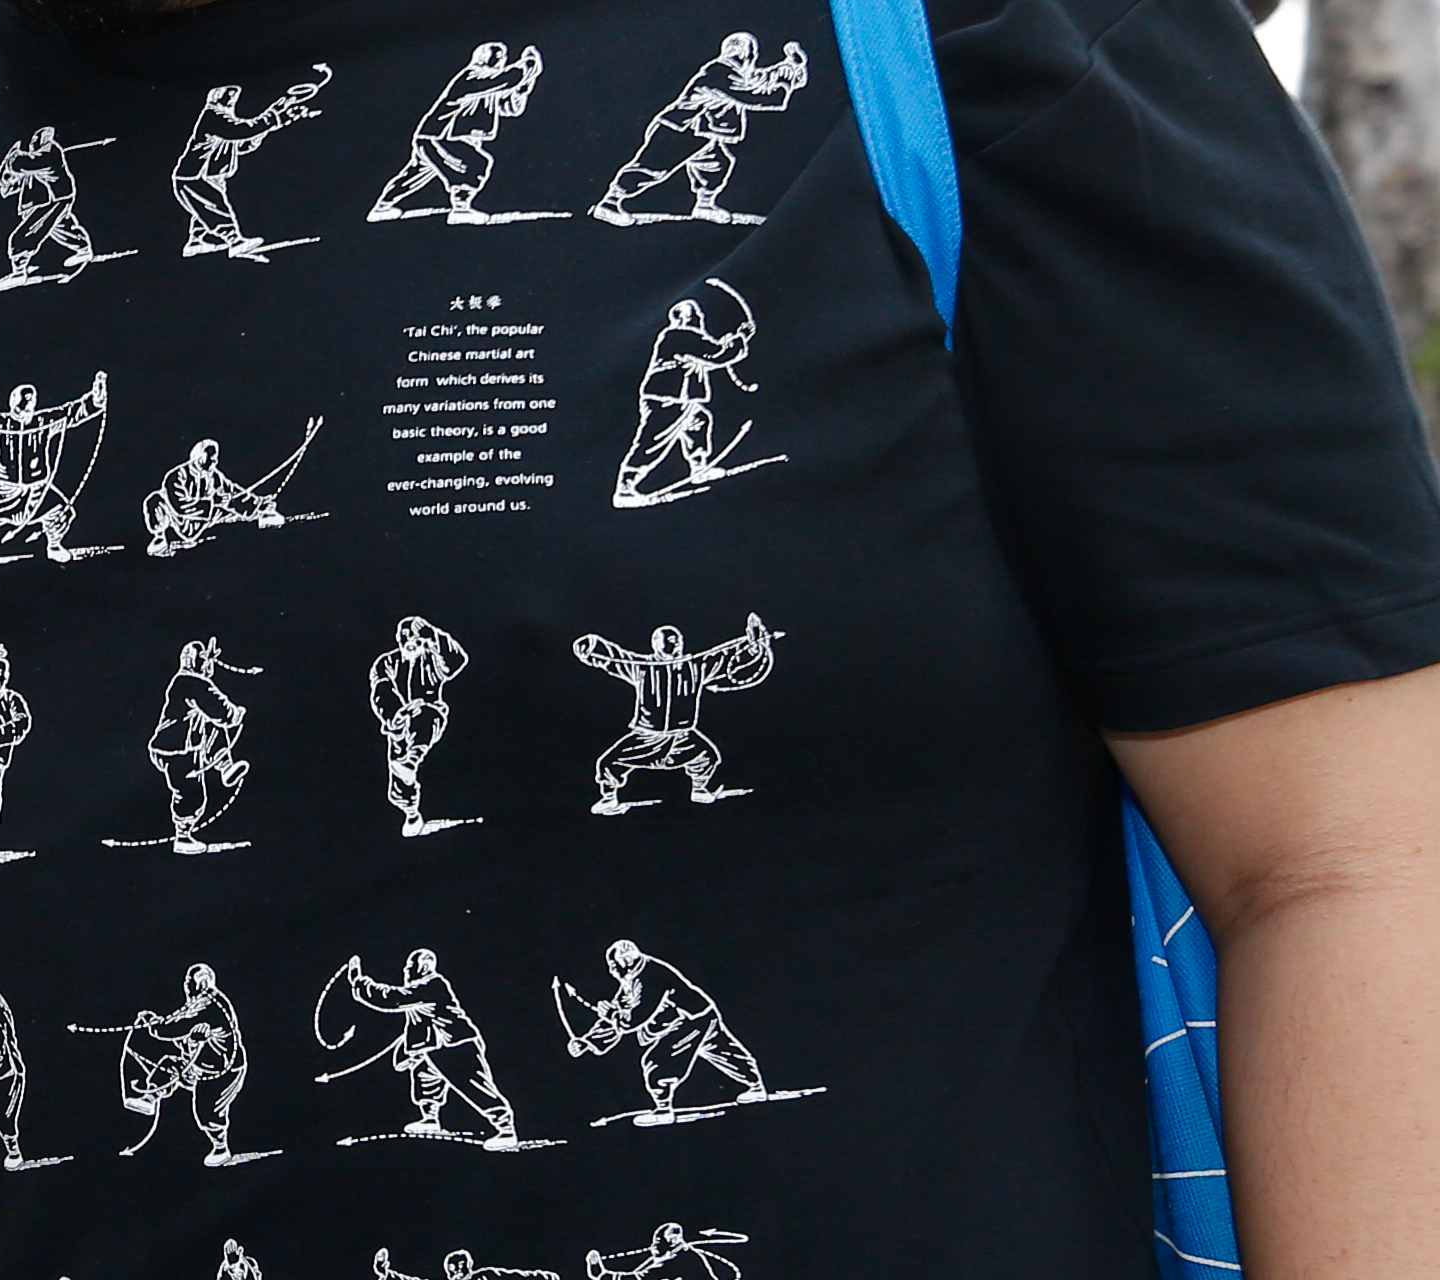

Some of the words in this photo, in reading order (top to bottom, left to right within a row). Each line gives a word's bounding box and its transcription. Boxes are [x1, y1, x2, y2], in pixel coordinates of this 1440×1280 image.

[465, 323, 489, 336] the
[491, 322, 545, 338] popular
[407, 350, 462, 363] Chinese
[465, 347, 513, 361] martial
[514, 348, 535, 360] art
[396, 376, 429, 389] form
[435, 373, 477, 387] which
[479, 372, 526, 385] derives
[528, 372, 545, 385] its
[382, 403, 422, 416] many
[423, 398, 490, 412] variations
[492, 397, 526, 410] from
[528, 398, 557, 410] one
[392, 426, 427, 440] basic
[430, 425, 479, 439] theory,
[482, 423, 494, 436] is
[497, 425, 507, 436] a
[509, 422, 548, 438] good
[416, 449, 475, 465] example
[478, 448, 495, 461] of
[498, 447, 522, 461] the
[387, 475, 490, 492] ever-changing,
[494, 472, 554, 487] evolving
[408, 502, 450, 517] world
[453, 498, 506, 514] around
[509, 500, 531, 511] us.
